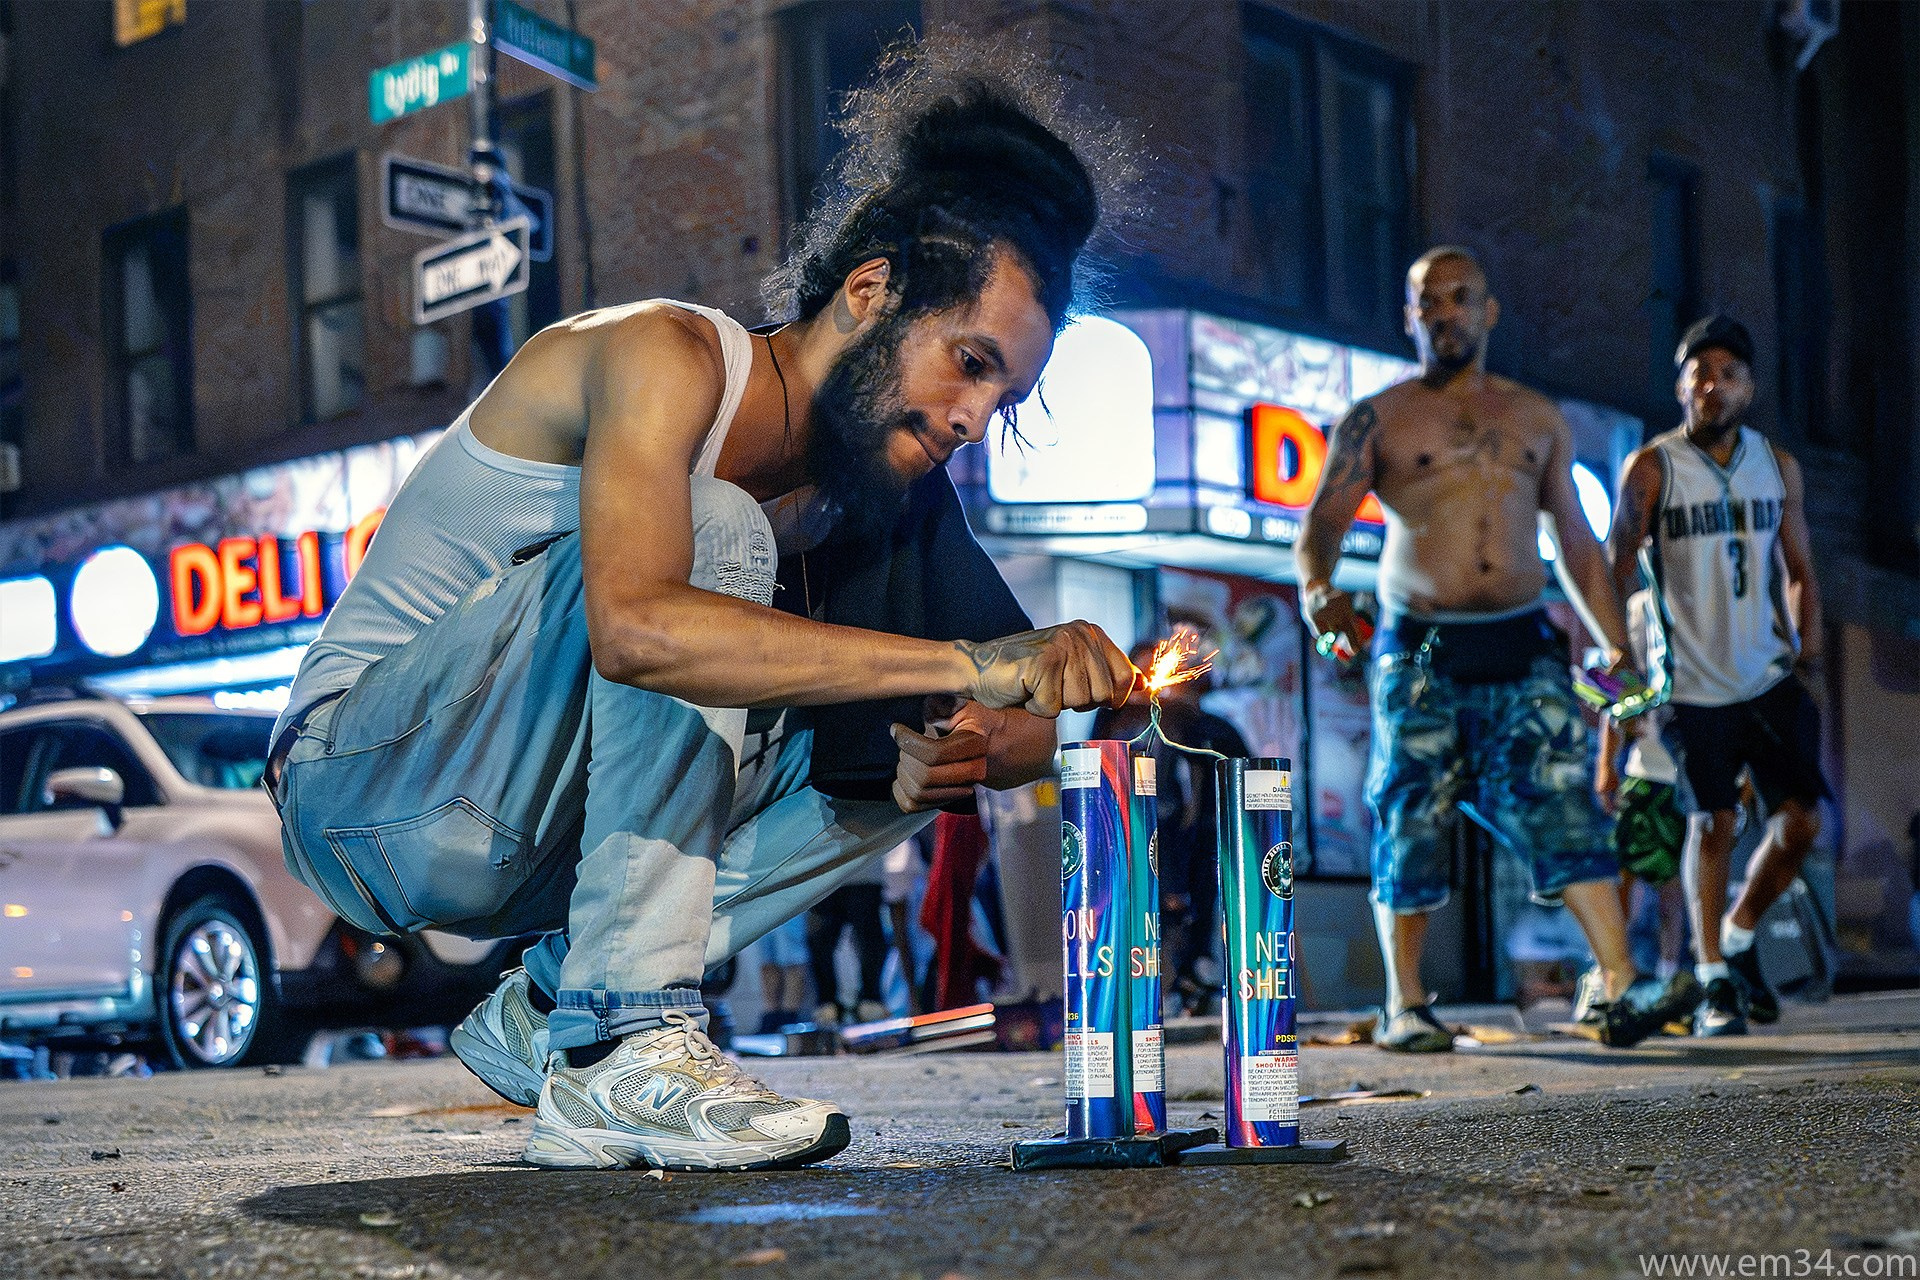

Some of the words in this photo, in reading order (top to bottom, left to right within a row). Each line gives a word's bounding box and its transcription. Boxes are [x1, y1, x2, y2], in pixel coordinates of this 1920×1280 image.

[170, 531, 323, 636] DELI
[1728, 538, 1747, 599] 3
[1066, 909, 1094, 940] ON
[1256, 931, 1295, 962] NEO
[1238, 968, 1296, 1000] SHEL
